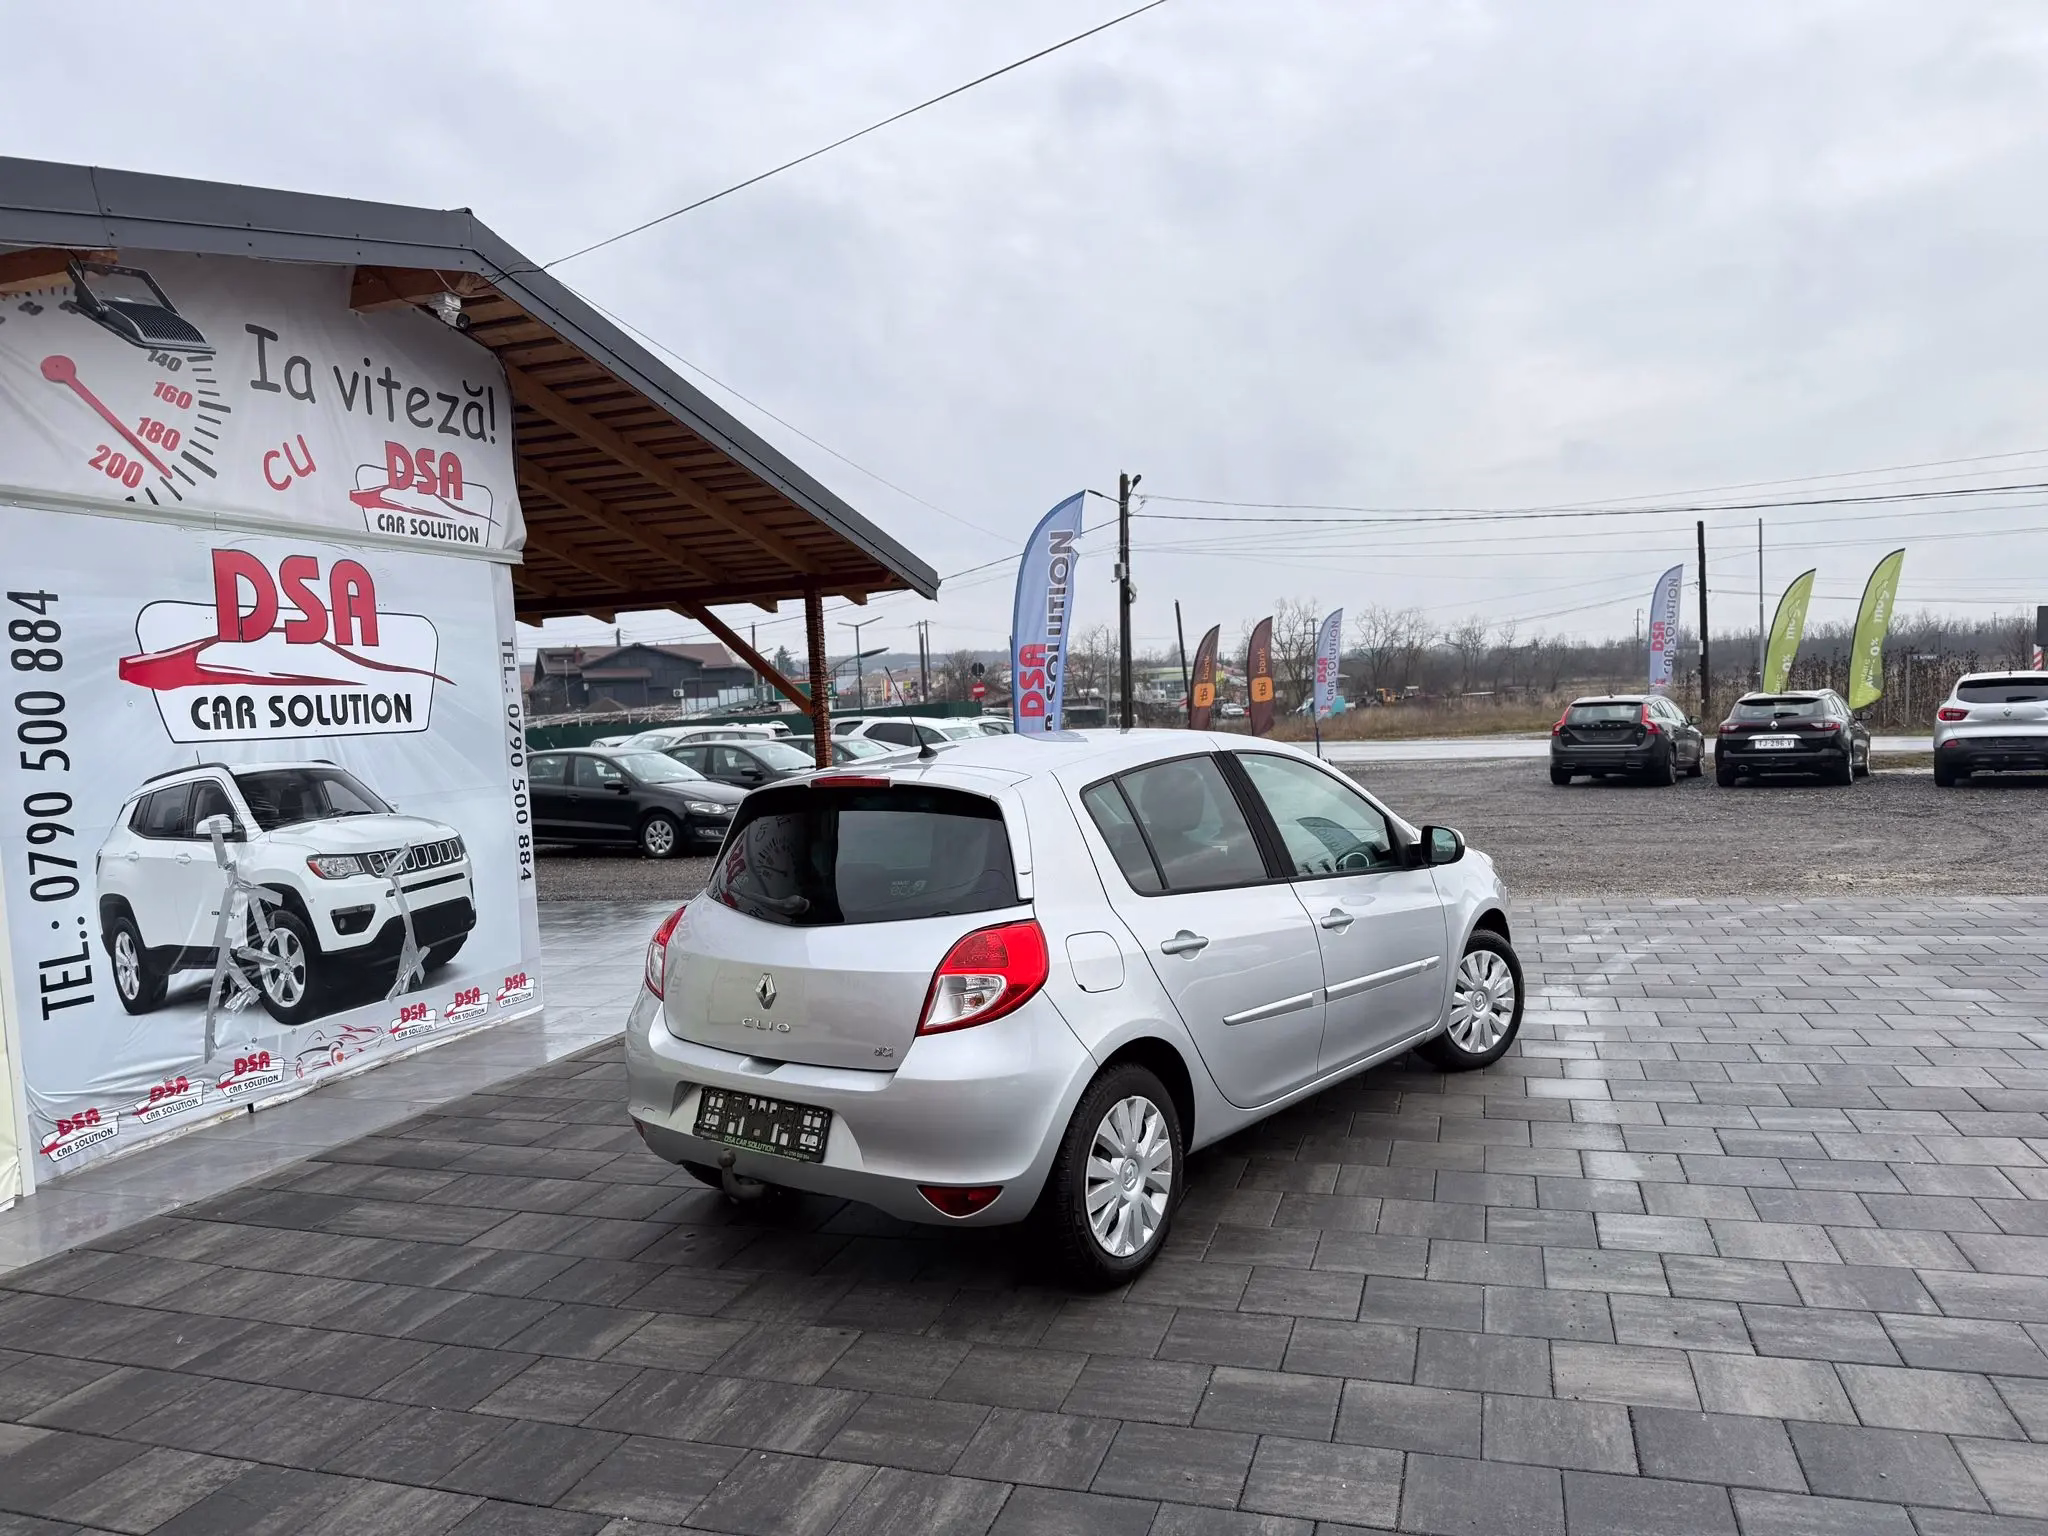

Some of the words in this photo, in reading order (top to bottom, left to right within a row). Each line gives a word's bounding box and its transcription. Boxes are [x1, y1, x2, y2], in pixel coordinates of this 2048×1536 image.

[148, 350, 182, 372] 140
[153, 381, 193, 410] 160
[245, 323, 316, 404] Ia
[333, 357, 496, 444] viteză!
[136, 417, 181, 451] 180
[88, 444, 144, 488] 200
[263, 434, 317, 491] cu
[385, 440, 463, 500] DSA
[377, 514, 405, 534] CAR
[410, 519, 479, 544] SOLUTION
[211, 548, 380, 647] DSA
[1664, 578, 1679, 645] SOLUTION
[7, 589, 63, 672] 884
[1652, 621, 1665, 651] DSA
[1257, 647, 1265, 674] bank
[1327, 620, 1340, 676] SOLUTION
[1019, 643, 1046, 717] DSA
[1317, 657, 1328, 683] DSA
[191, 695, 257, 731] CAR
[268, 692, 413, 728] SOLUTION
[14, 691, 71, 771] 500
[507, 703, 523, 767] 0790
[512, 778, 528, 824] 500
[23, 791, 80, 902] 0790
[518, 834, 532, 881] 884
[39, 916, 95, 1021] TEL.:
[504, 972, 527, 991] DSA
[454, 987, 480, 1007] DSA
[511, 992, 532, 1003] SOLUTION
[400, 1002, 427, 1023] DSA
[451, 1014, 462, 1022] CAR
[462, 1008, 485, 1019] SOLUTION
[742, 1018, 791, 1033] CLIO
[397, 1030, 408, 1038] CAR
[408, 1024, 433, 1035] SOLUTION
[234, 1051, 270, 1076] DSA
[149, 1075, 189, 1103] DSA
[229, 1085, 243, 1094] CAR
[244, 1074, 279, 1090] SOLUTION
[56, 1107, 101, 1137] DSA
[146, 1110, 161, 1121] CAR
[162, 1097, 199, 1116] SOLUTION
[56, 1145, 73, 1157] CAR
[74, 1127, 114, 1149] SOLUTION
[724, 1135, 736, 1145] DSA
[736, 1137, 748, 1147] CAR
[748, 1139, 776, 1153] SOLUTION
